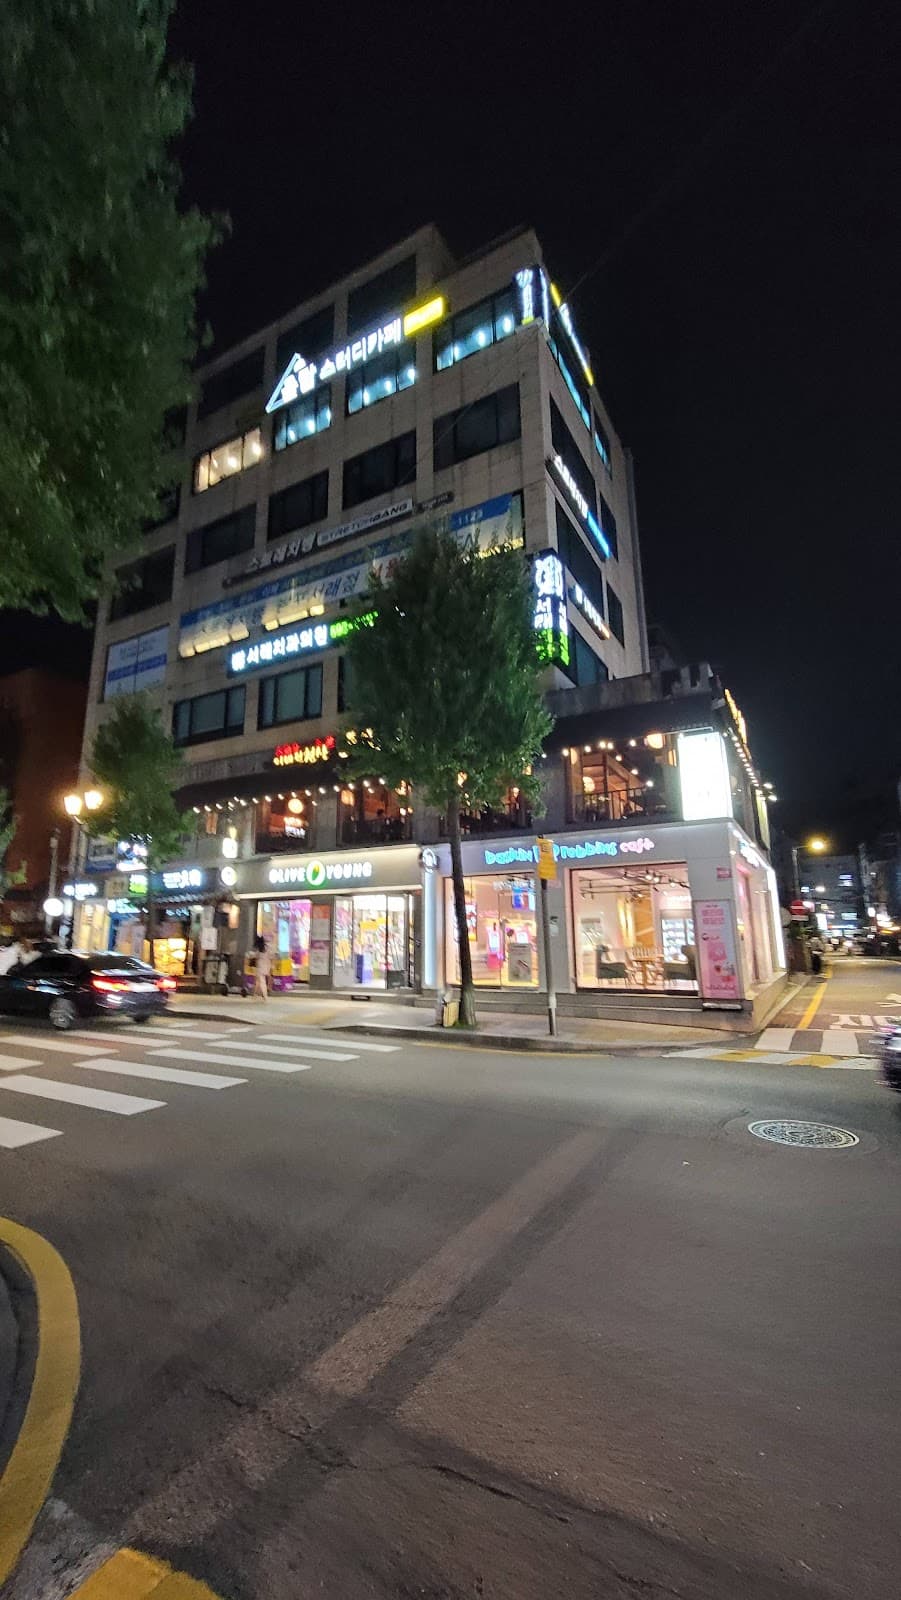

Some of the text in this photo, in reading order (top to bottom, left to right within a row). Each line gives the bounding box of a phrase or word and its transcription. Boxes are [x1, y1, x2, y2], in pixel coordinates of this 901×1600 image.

[320, 318, 402, 379] 스터디카페
[484, 847, 533, 865] baskin
[560, 841, 617, 859] robbins
[268, 862, 373, 883] OLIVE YOUNG
